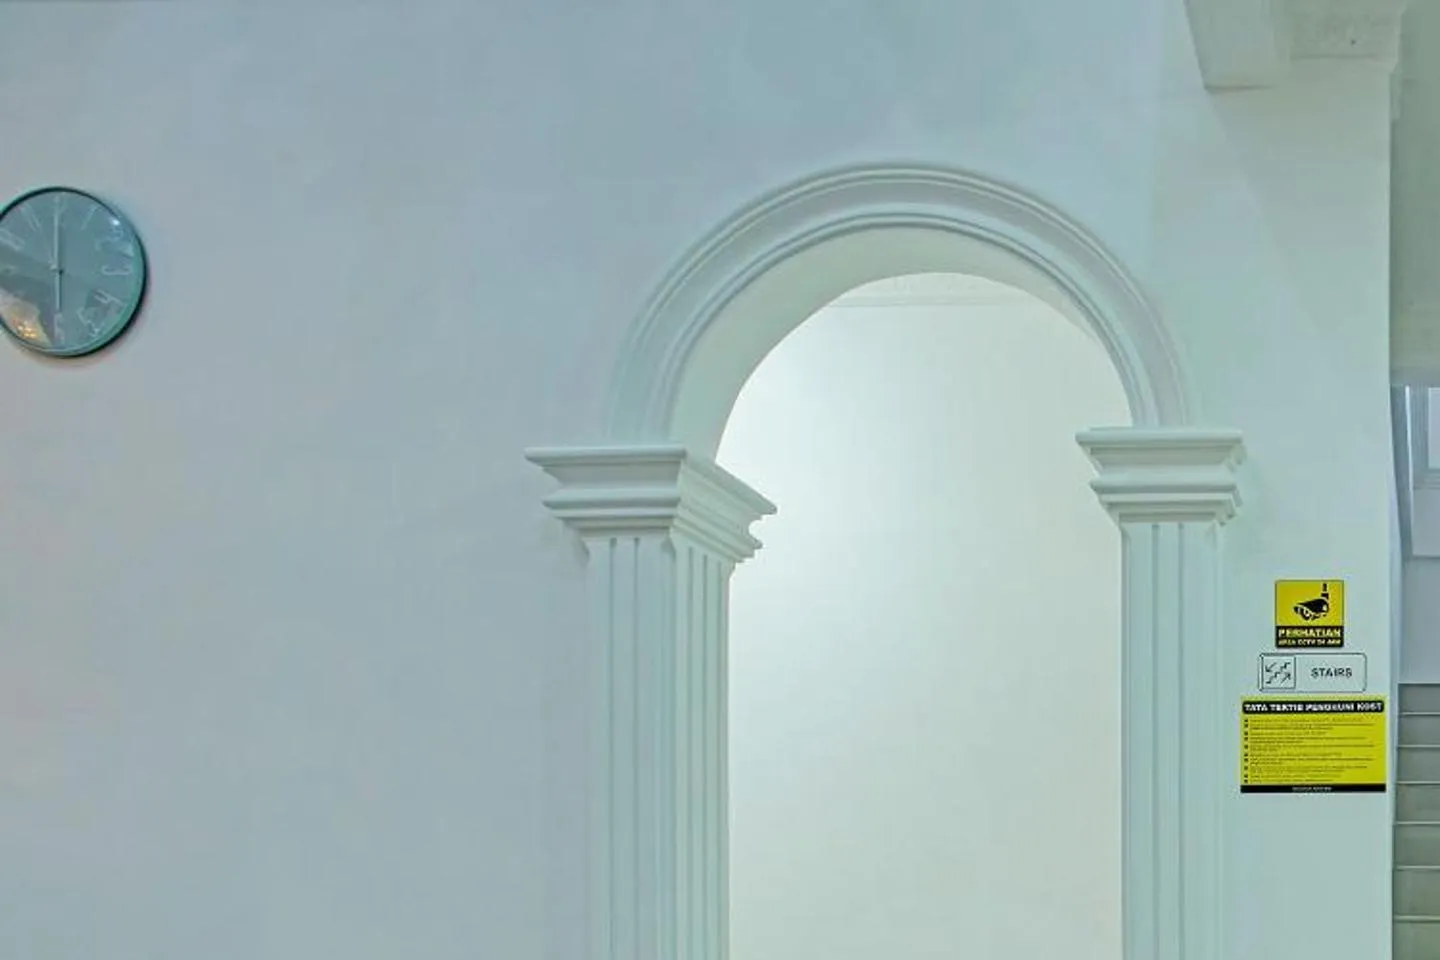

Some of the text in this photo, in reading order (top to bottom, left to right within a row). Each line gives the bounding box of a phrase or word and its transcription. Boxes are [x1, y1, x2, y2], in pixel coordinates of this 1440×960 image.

[1278, 628, 1341, 638] PERHATIAN
[1311, 667, 1352, 677] STAIRS
[1244, 702, 1382, 712] TATA TERTIB PENGHUNI KOST
